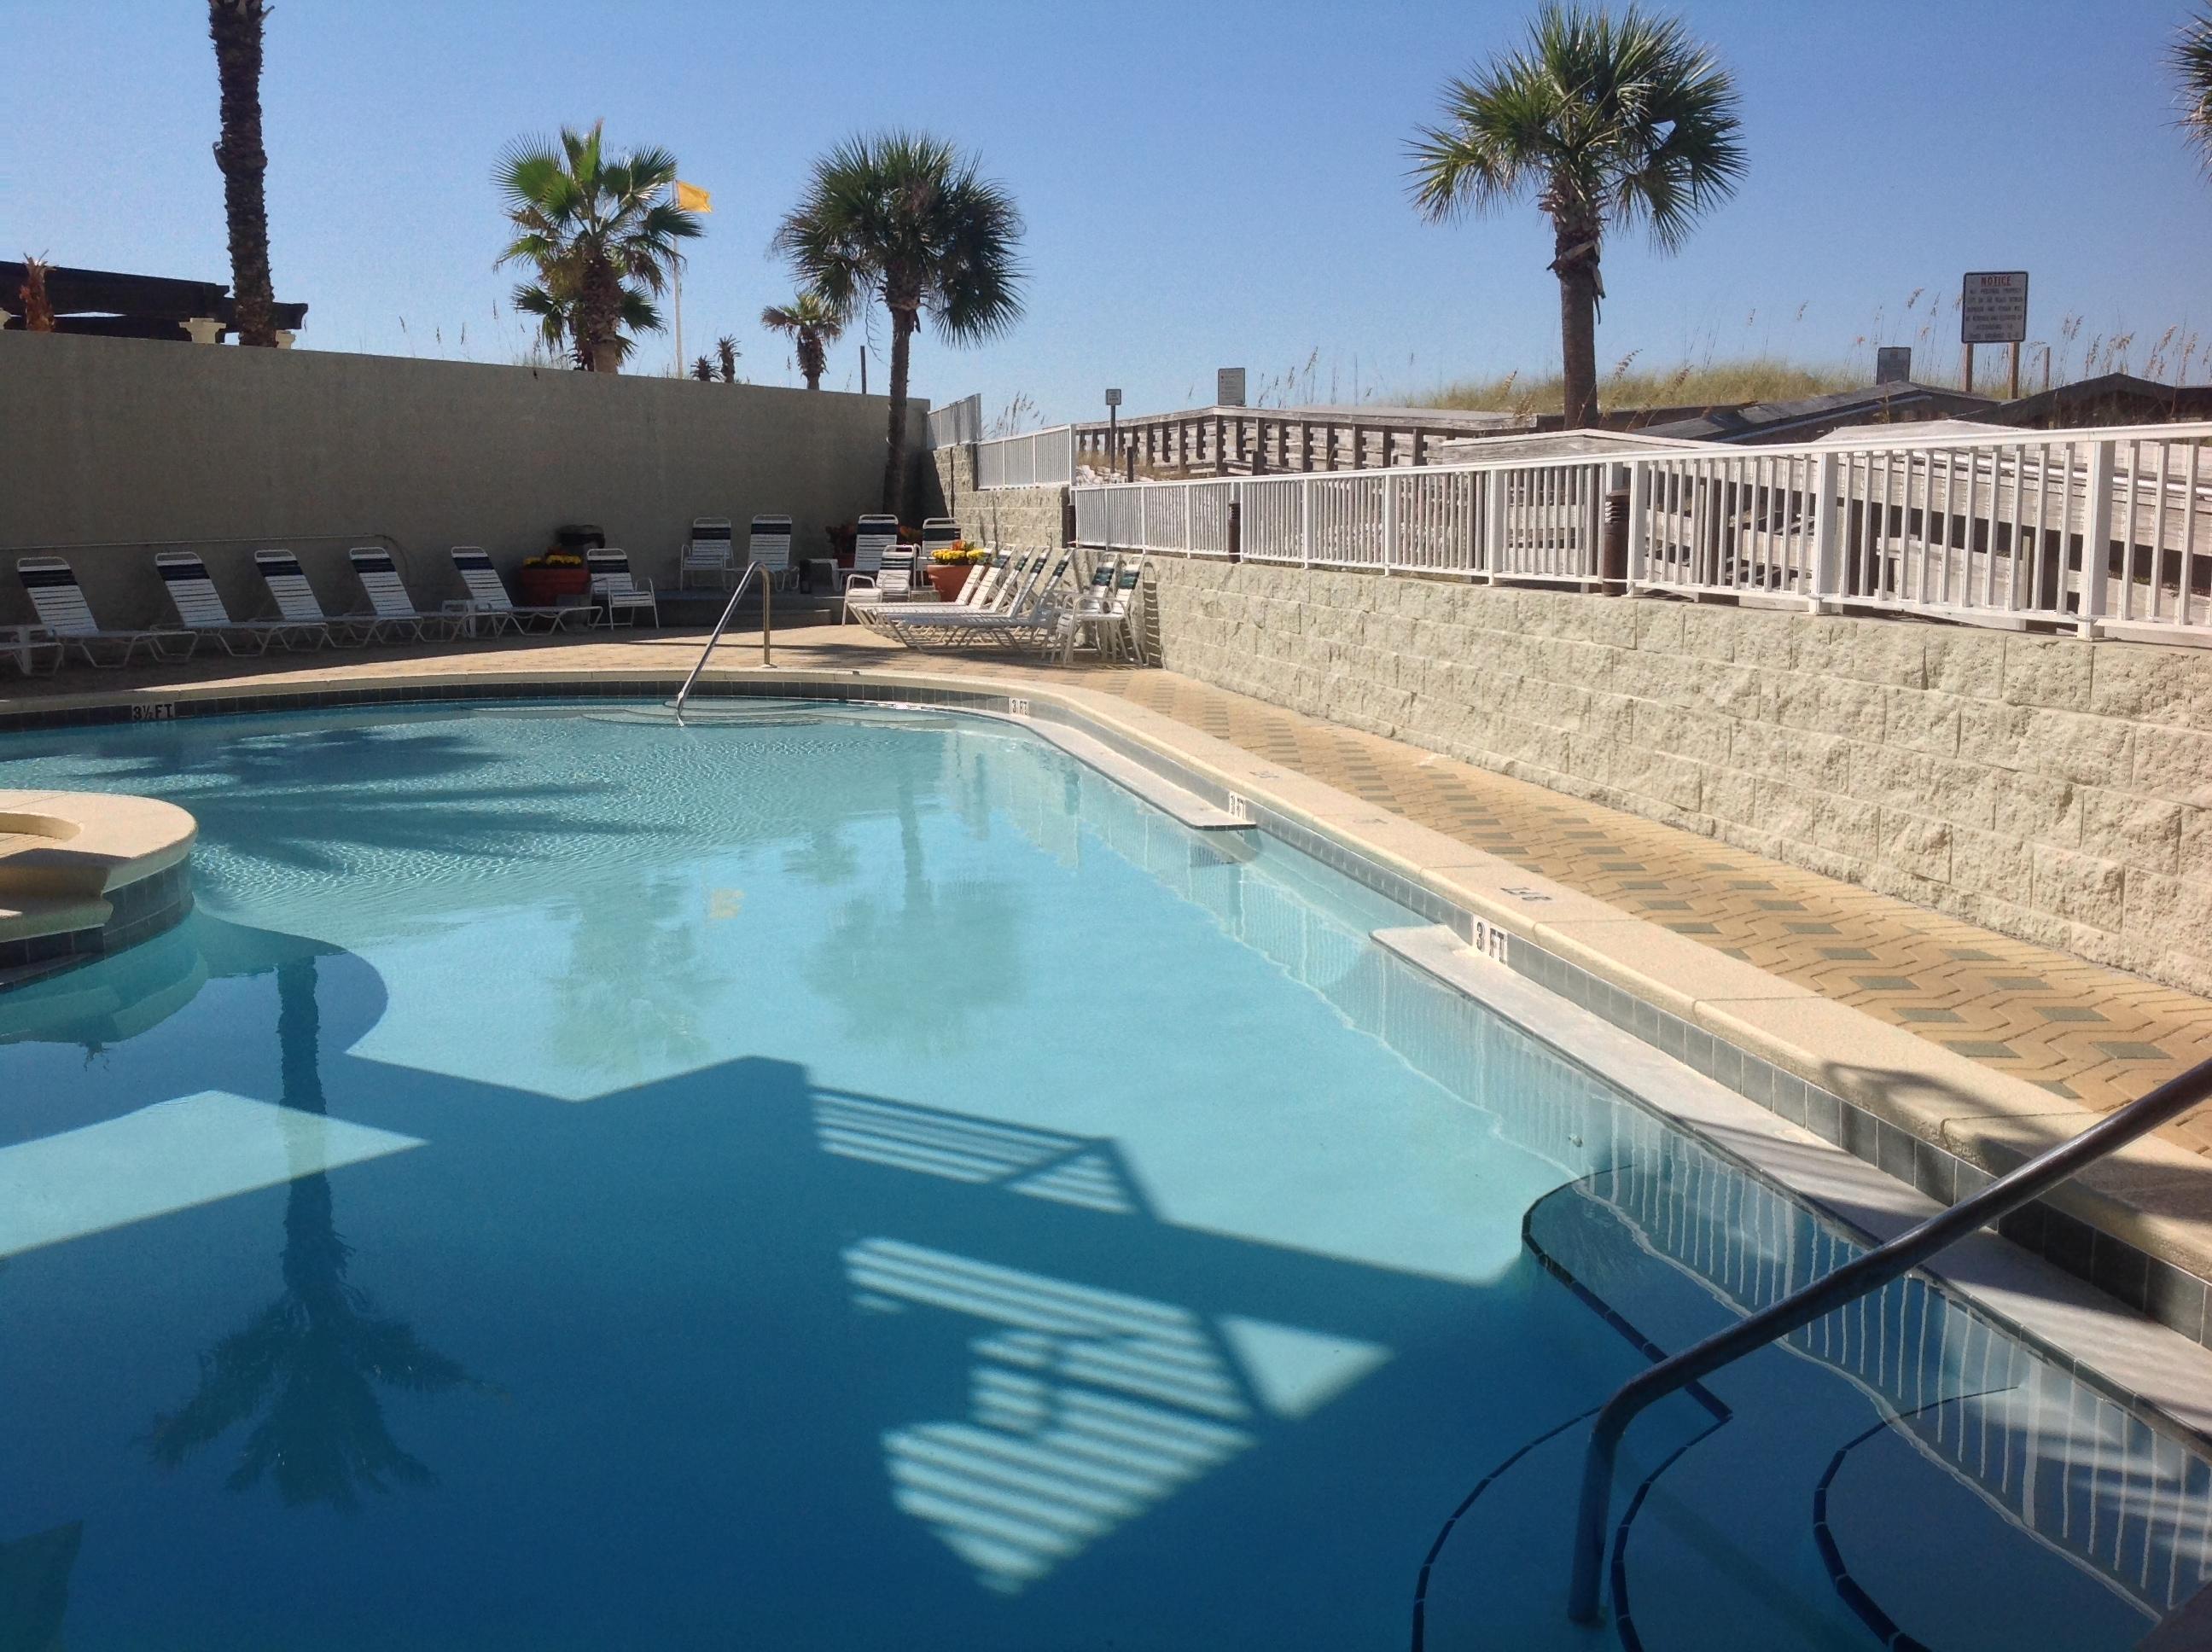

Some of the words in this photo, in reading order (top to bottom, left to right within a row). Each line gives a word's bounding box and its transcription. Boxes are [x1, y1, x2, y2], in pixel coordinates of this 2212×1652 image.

[1981, 276, 2011, 287] NOTICE
[155, 703, 173, 718] FT
[1476, 921, 1485, 952] 3
[1489, 928, 1506, 965] FT
